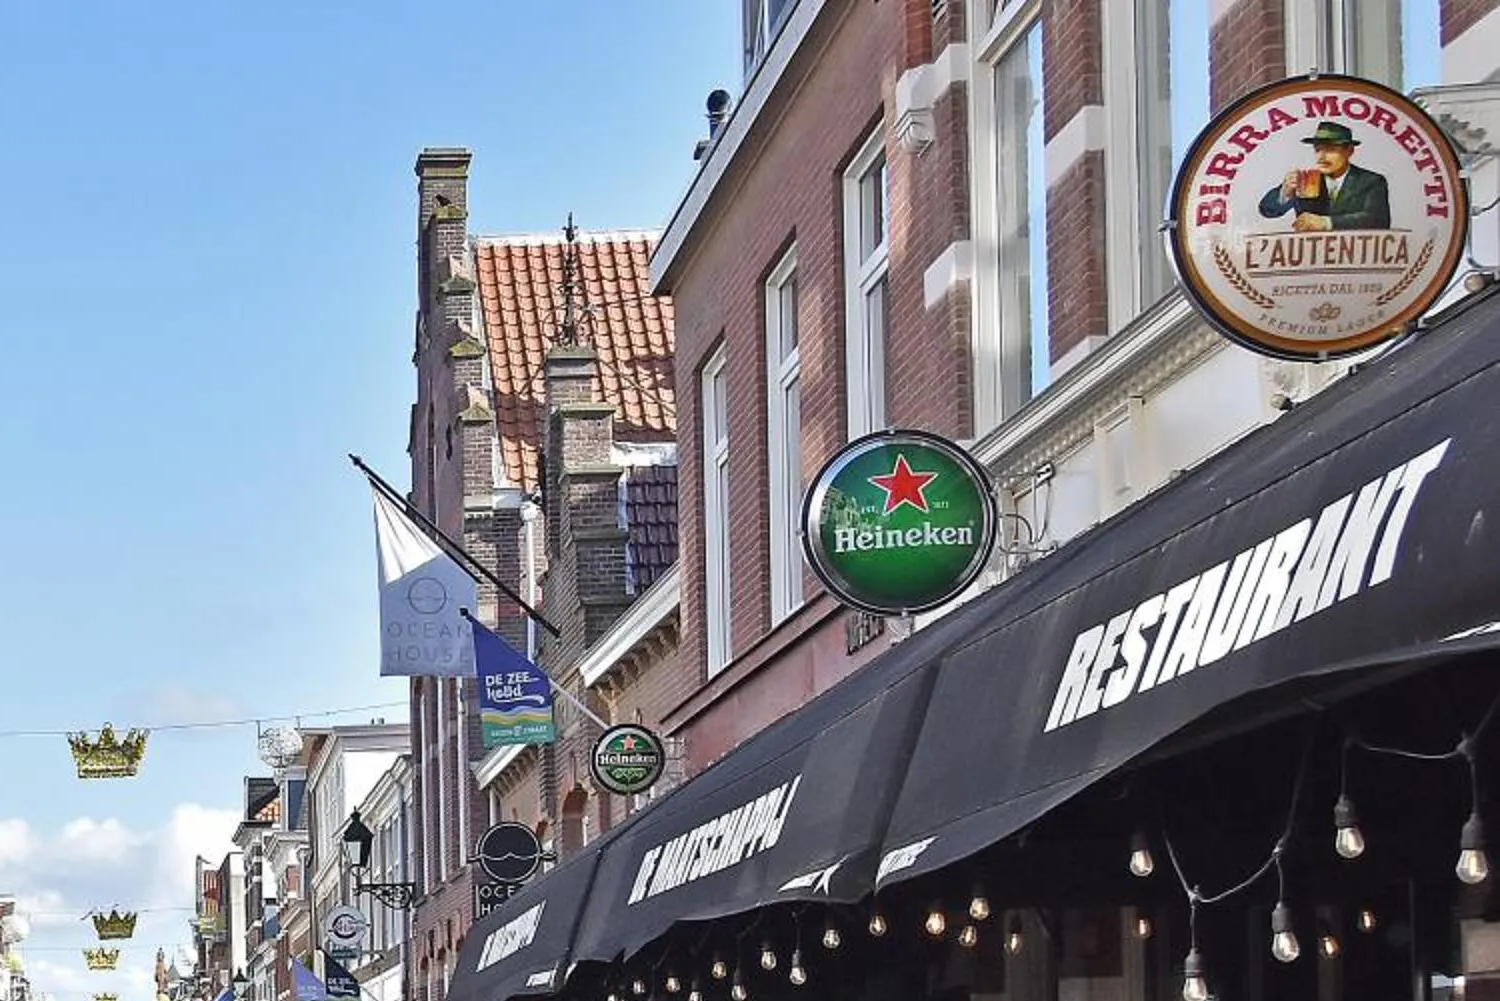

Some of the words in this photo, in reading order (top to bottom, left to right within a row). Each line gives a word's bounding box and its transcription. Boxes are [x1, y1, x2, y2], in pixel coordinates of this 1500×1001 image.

[1196, 107, 1298, 227] BIRRA
[1301, 95, 1449, 219] MORETTI
[1245, 233, 1410, 270] L'AUTENTICA
[834, 520, 974, 553] Heineken
[1043, 437, 1453, 734] RESTAURANT
[387, 621, 471, 640] OCEAN
[389, 645, 470, 665] HOUSE
[485, 673, 503, 687] DE
[599, 752, 657, 765] Heineken
[479, 885, 516, 899] OCE
